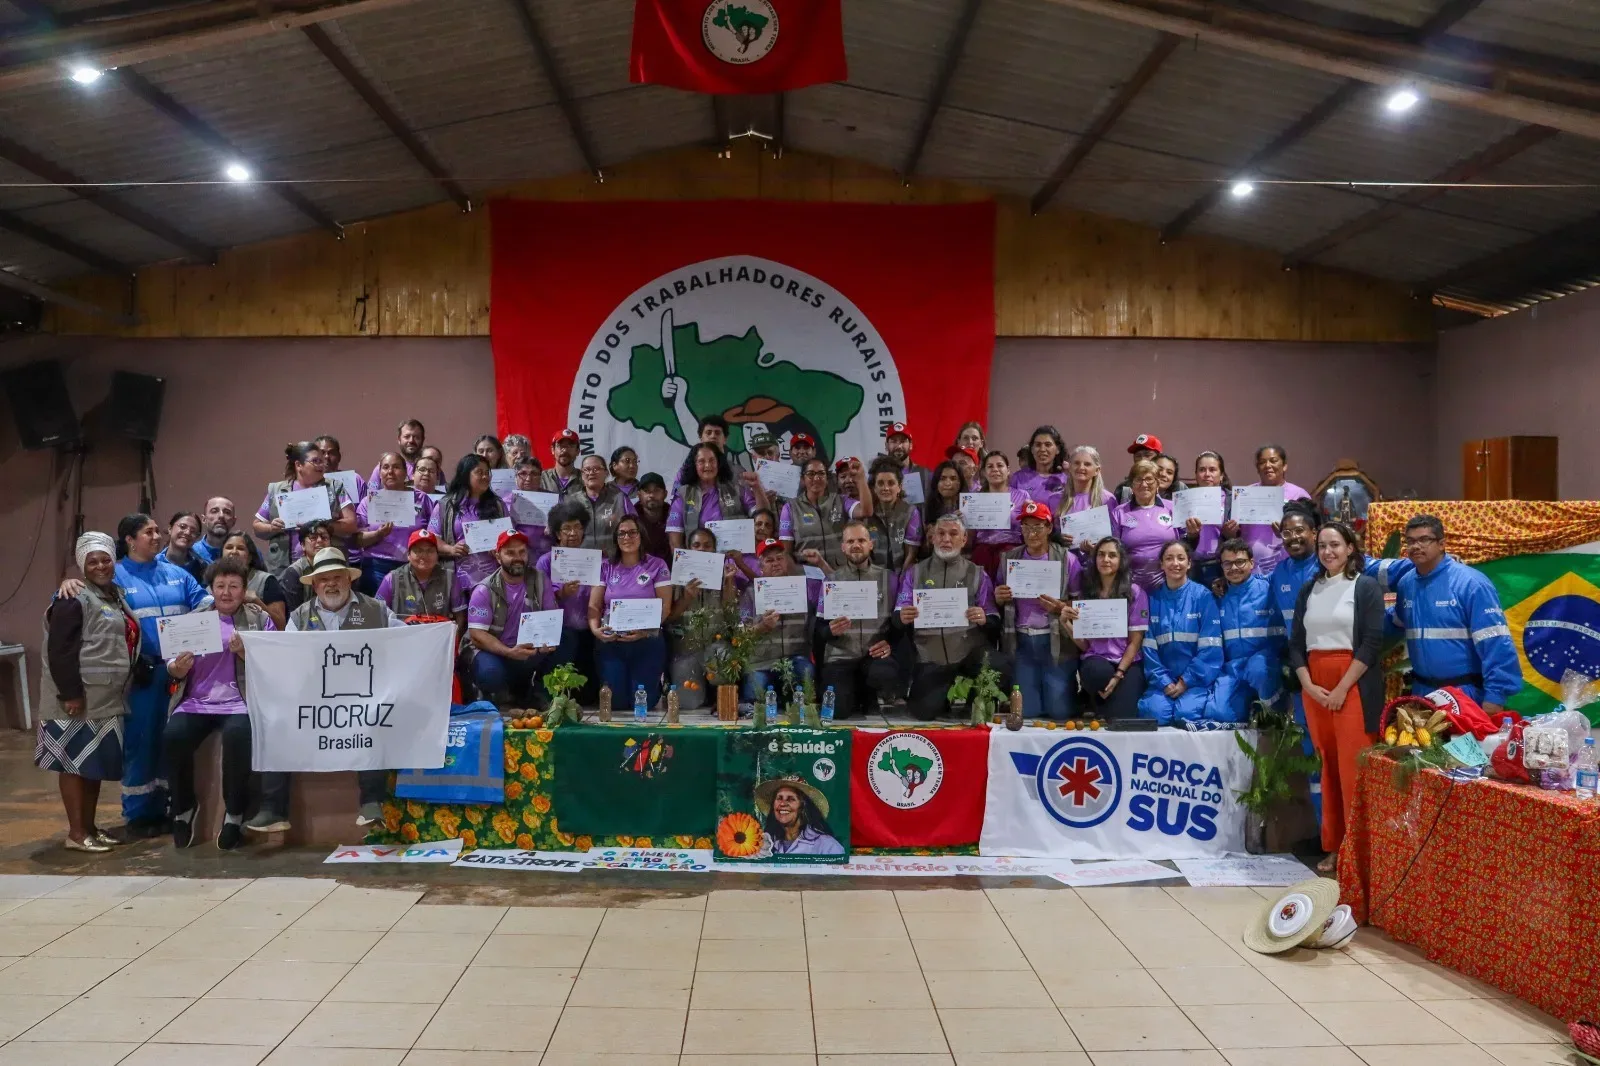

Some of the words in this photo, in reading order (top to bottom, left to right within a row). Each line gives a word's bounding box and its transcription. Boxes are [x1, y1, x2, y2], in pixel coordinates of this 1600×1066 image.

[578, 372, 602, 456] MENTO
[595, 320, 631, 365] DOS
[631, 266, 826, 320] TRABALHADORES
[828, 306, 887, 384] RURAIS
[876, 392, 895, 438] SEM
[298, 703, 395, 729] FIOCRUZ
[318, 734, 373, 750] Brasília
[447, 735, 466, 747] US
[768, 739, 779, 752] é
[879, 733, 927, 748] TRABALHADORES
[872, 748, 880, 760] DOS
[927, 743, 940, 762] RURAIS
[869, 761, 881, 795] MOVIMENTO
[1131, 752, 1223, 790] FORÇA
[929, 777, 941, 795] TERRA
[1130, 778, 1198, 800] NACIONAL
[1201, 790, 1222, 804] DO
[1126, 794, 1219, 841] SUS
[334, 850, 360, 858] A
